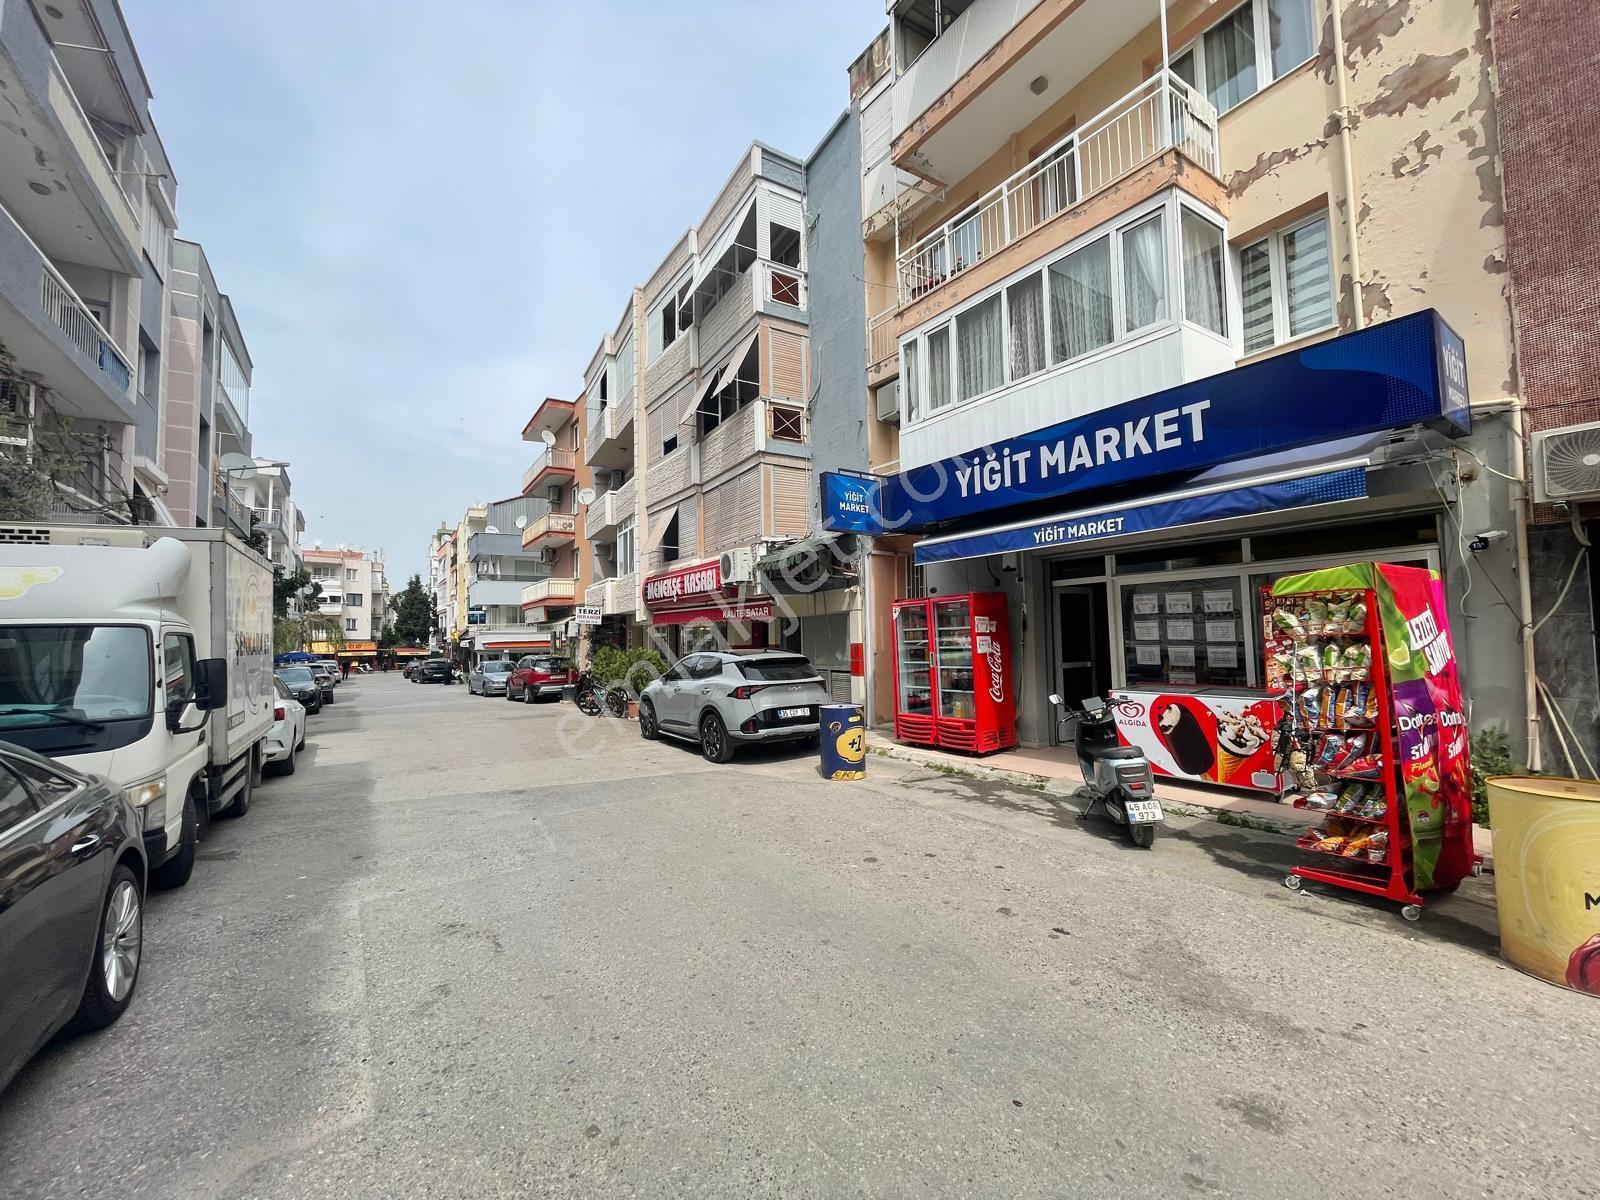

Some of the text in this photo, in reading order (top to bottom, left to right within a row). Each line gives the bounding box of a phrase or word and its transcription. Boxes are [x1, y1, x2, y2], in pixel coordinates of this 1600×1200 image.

[954, 400, 1211, 498] YİĞİT MARKET
[844, 491, 864, 503] YİĞİT
[839, 501, 870, 514] MARKET
[1033, 517, 1125, 544] YİĞİT MARKET
[647, 568, 717, 602] MENEKŞE KASABI
[745, 606, 769, 617] SATAR
[1128, 803, 1140, 811] 45
[1138, 811, 1156, 820] 973
